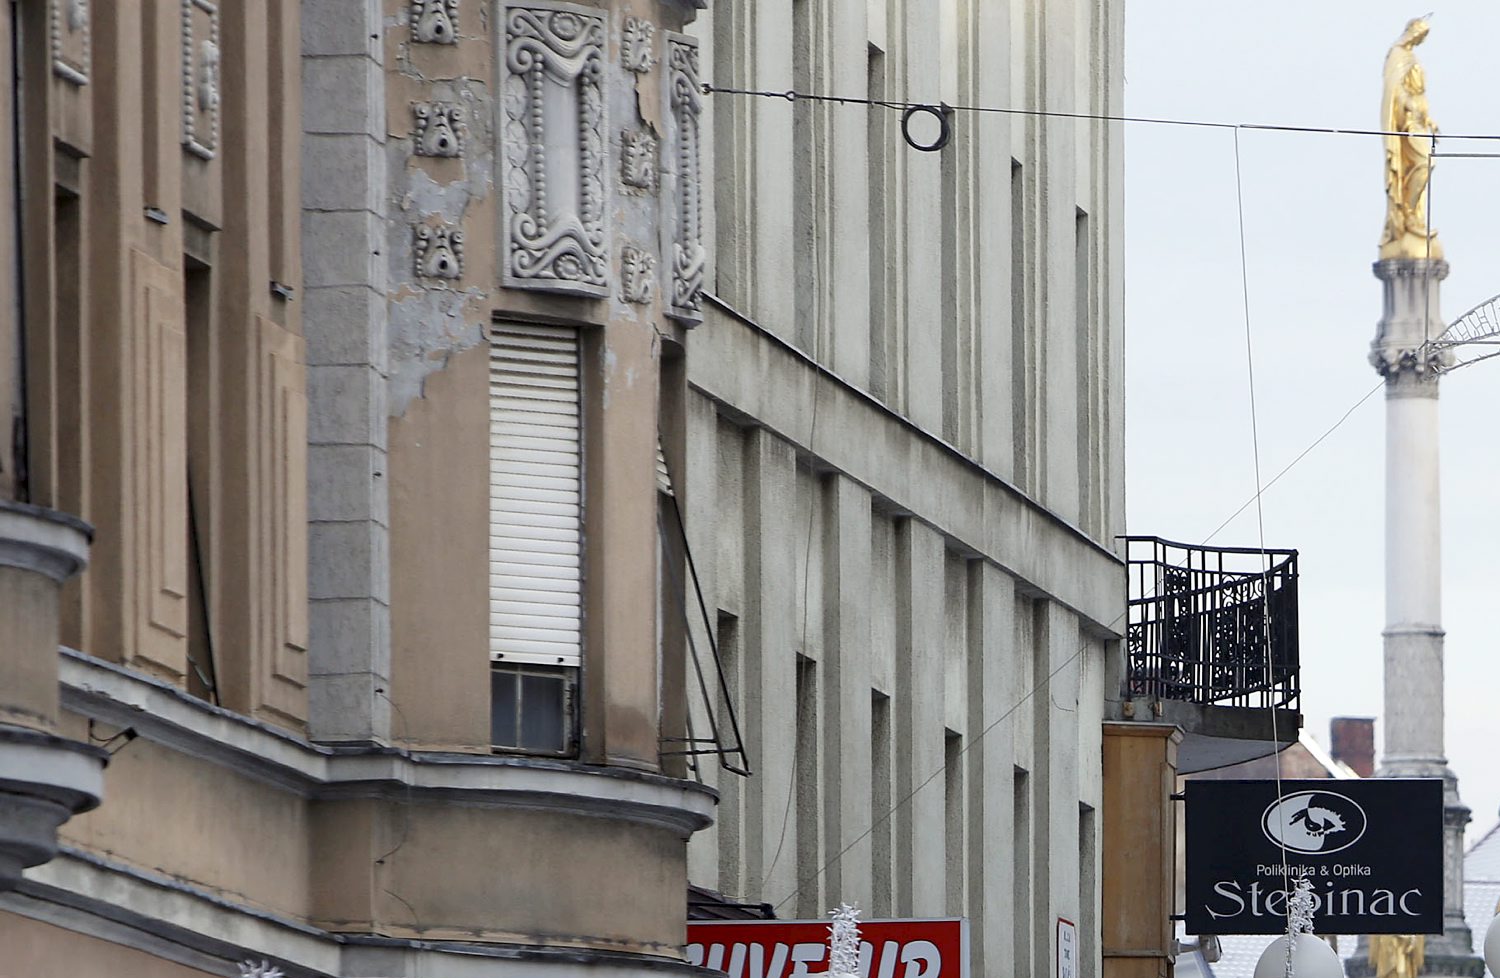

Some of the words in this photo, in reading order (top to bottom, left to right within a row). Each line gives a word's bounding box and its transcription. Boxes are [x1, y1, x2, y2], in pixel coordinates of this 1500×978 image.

[1257, 864, 1315, 876] Poliklinika
[1320, 865, 1329, 876] &
[1333, 864, 1371, 877] Optika
